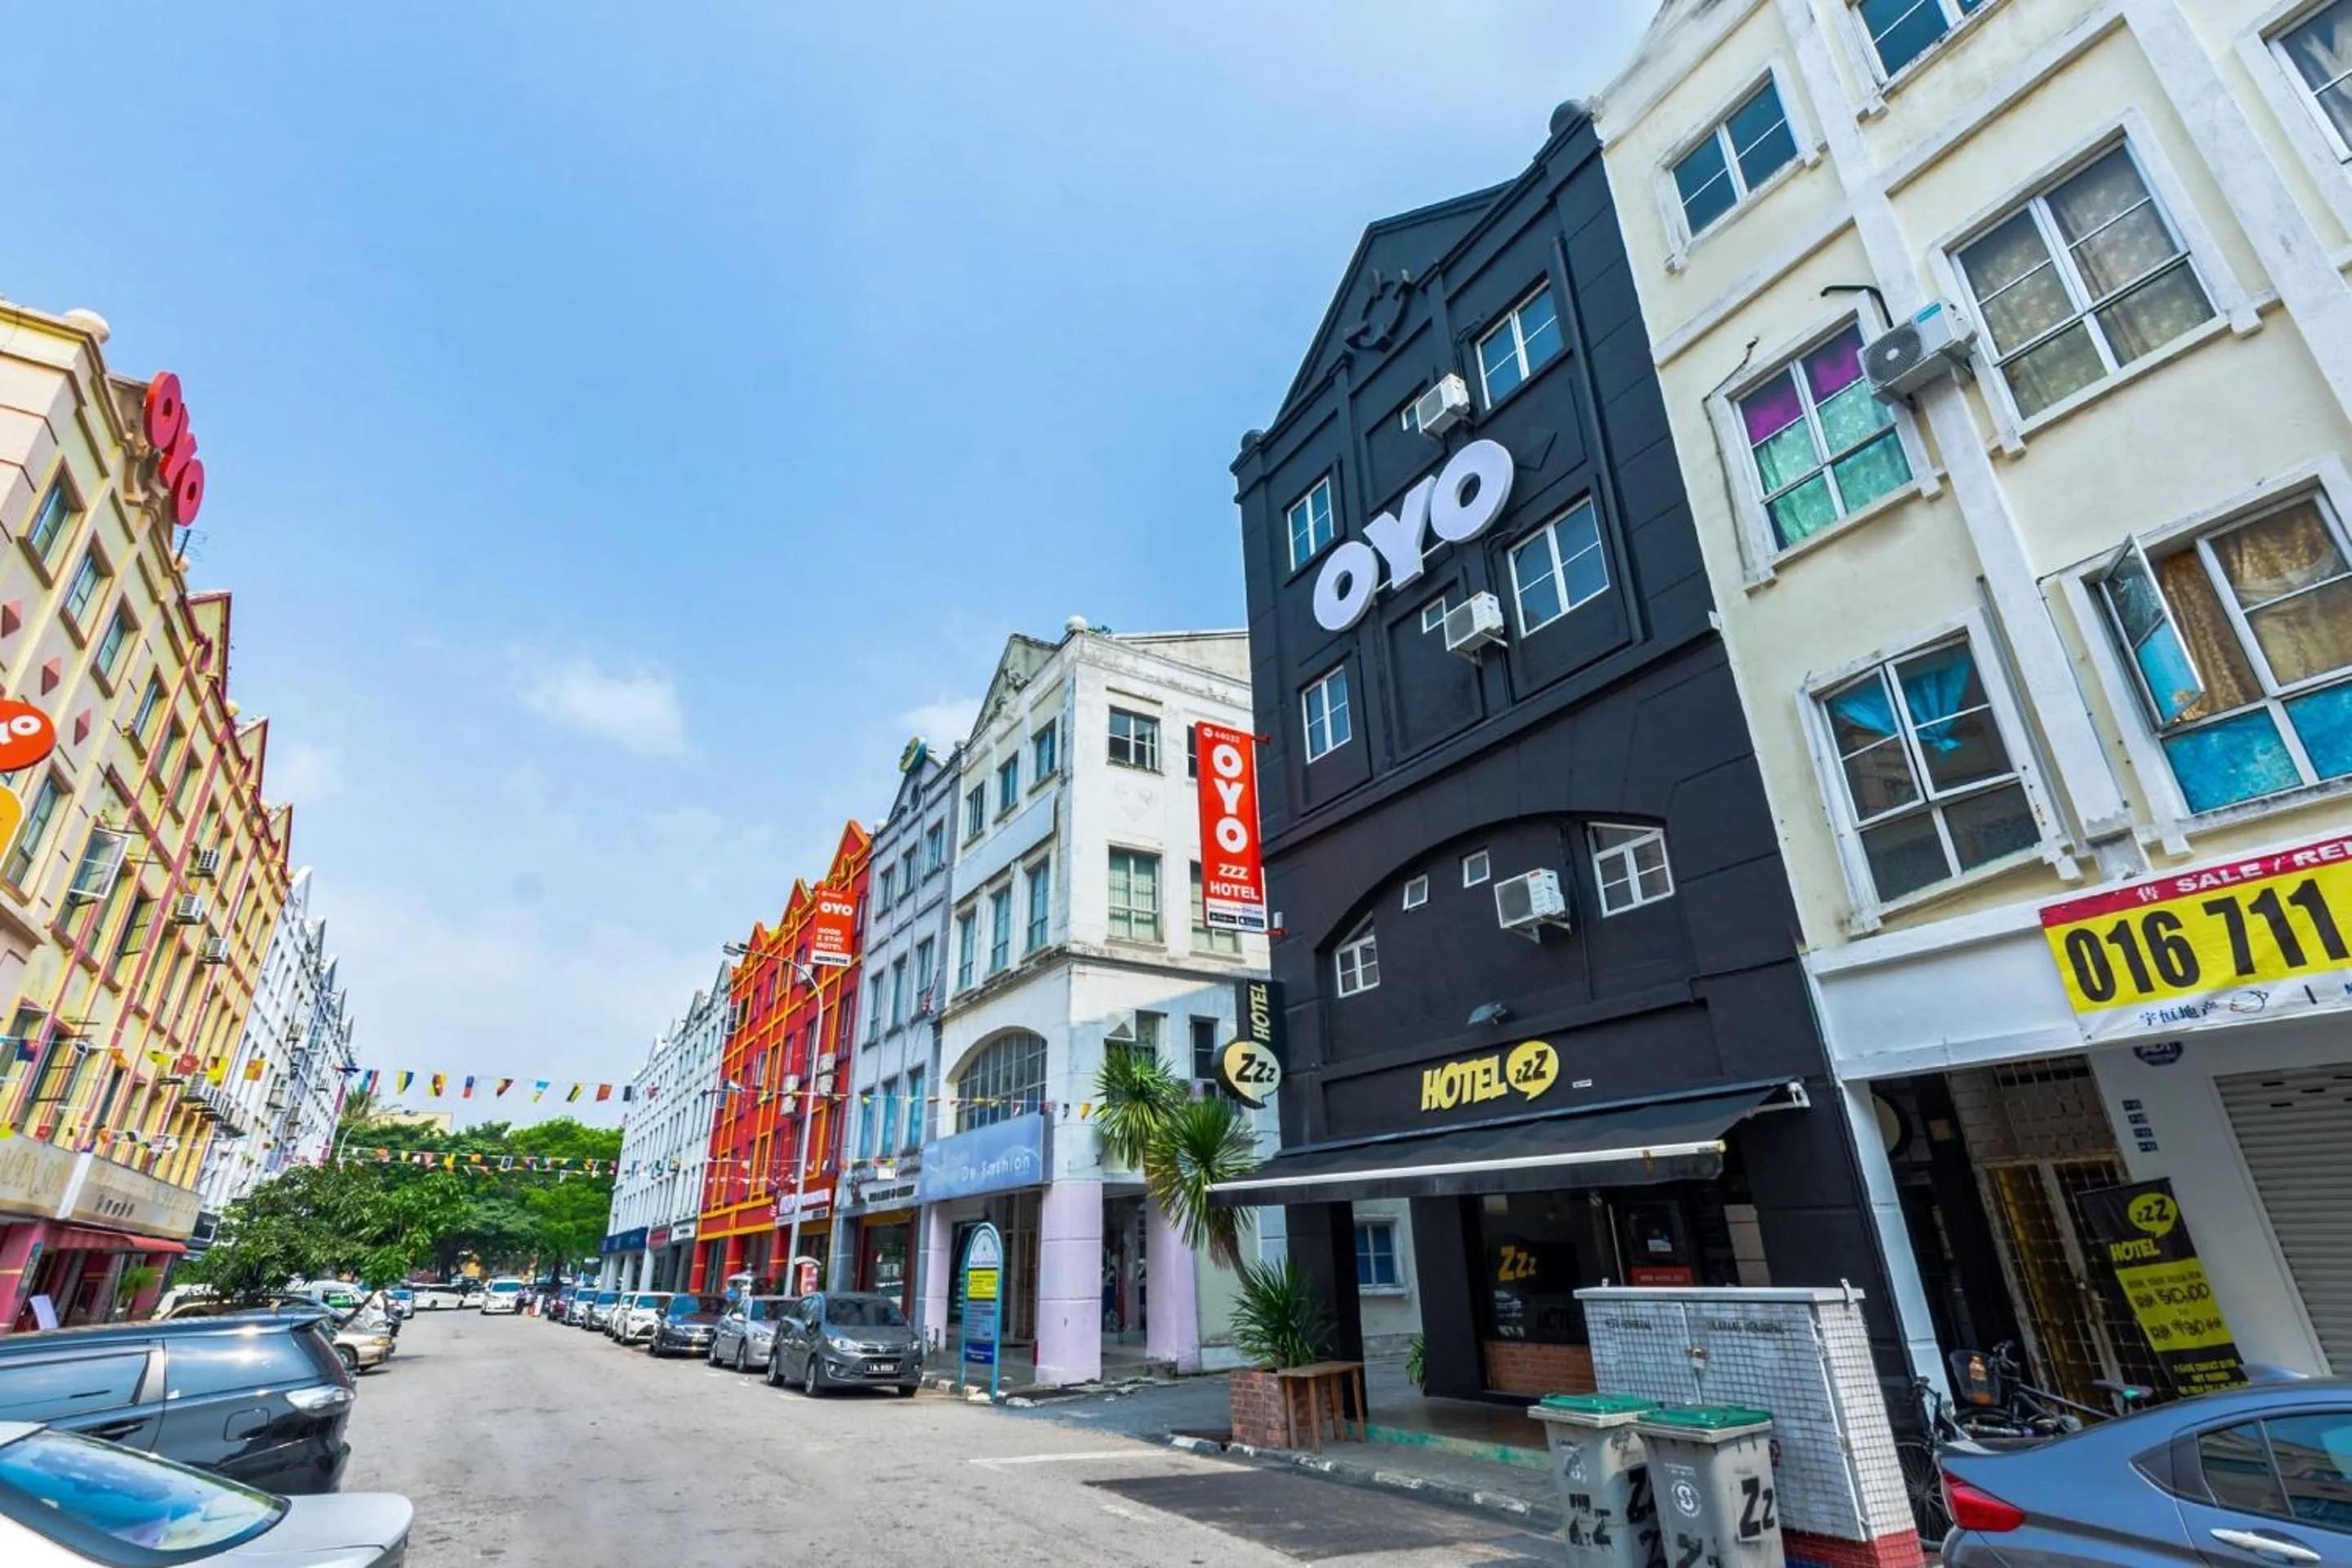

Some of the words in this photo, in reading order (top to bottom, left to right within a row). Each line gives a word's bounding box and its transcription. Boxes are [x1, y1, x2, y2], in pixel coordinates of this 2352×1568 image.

[143, 372, 204, 528] OYO
[1313, 439, 1513, 632] OYO
[1212, 744, 1249, 853] OYO
[1209, 880, 1260, 901] HOTEL
[2176, 862, 2263, 893] SALE
[820, 902, 853, 916] OYO
[2065, 911, 2201, 1003] 016
[2202, 878, 2351, 977] 711
[1250, 983, 1272, 1042] HOTEL
[1421, 1054, 1508, 1111] HOTEL
[2109, 1237, 2161, 1263] HOTEL
